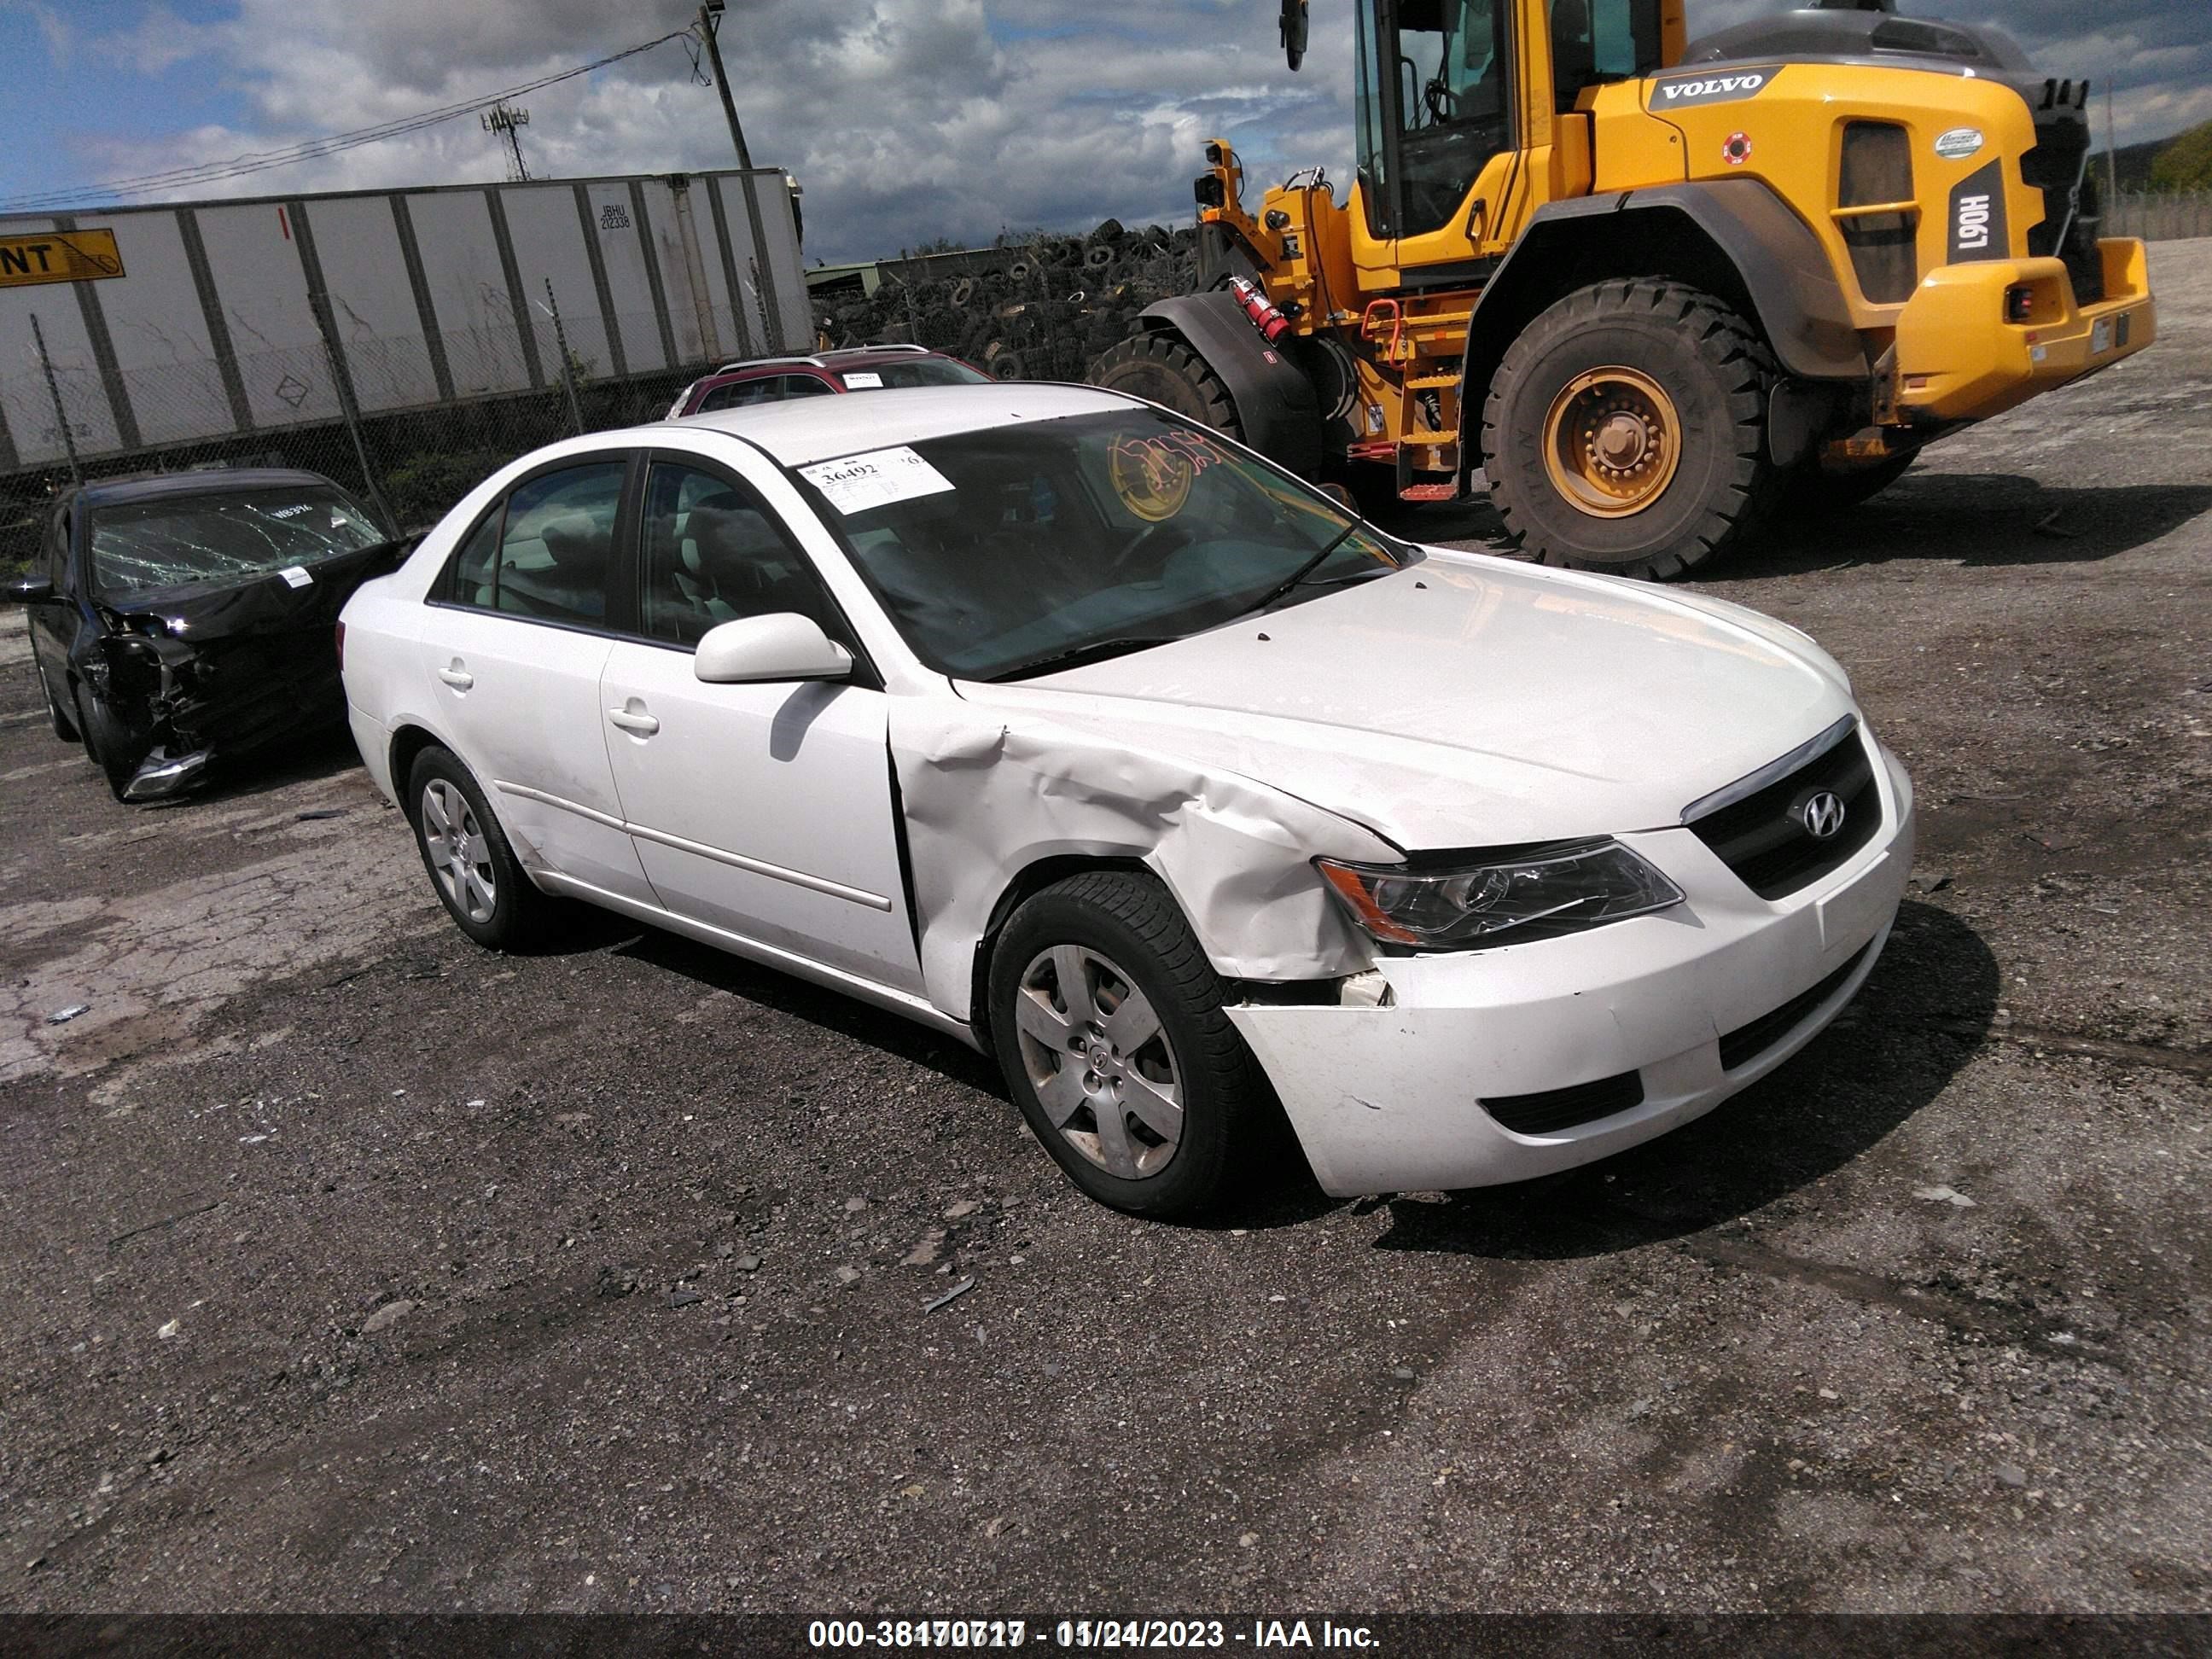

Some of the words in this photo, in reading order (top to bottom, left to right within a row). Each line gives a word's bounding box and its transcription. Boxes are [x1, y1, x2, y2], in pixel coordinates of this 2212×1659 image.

[1662, 74, 1763, 99] VOLVO
[602, 204, 626, 217] JBHU
[600, 216, 630, 230] 212338
[1958, 195, 1990, 249] L90H
[821, 464, 878, 485] 36492
